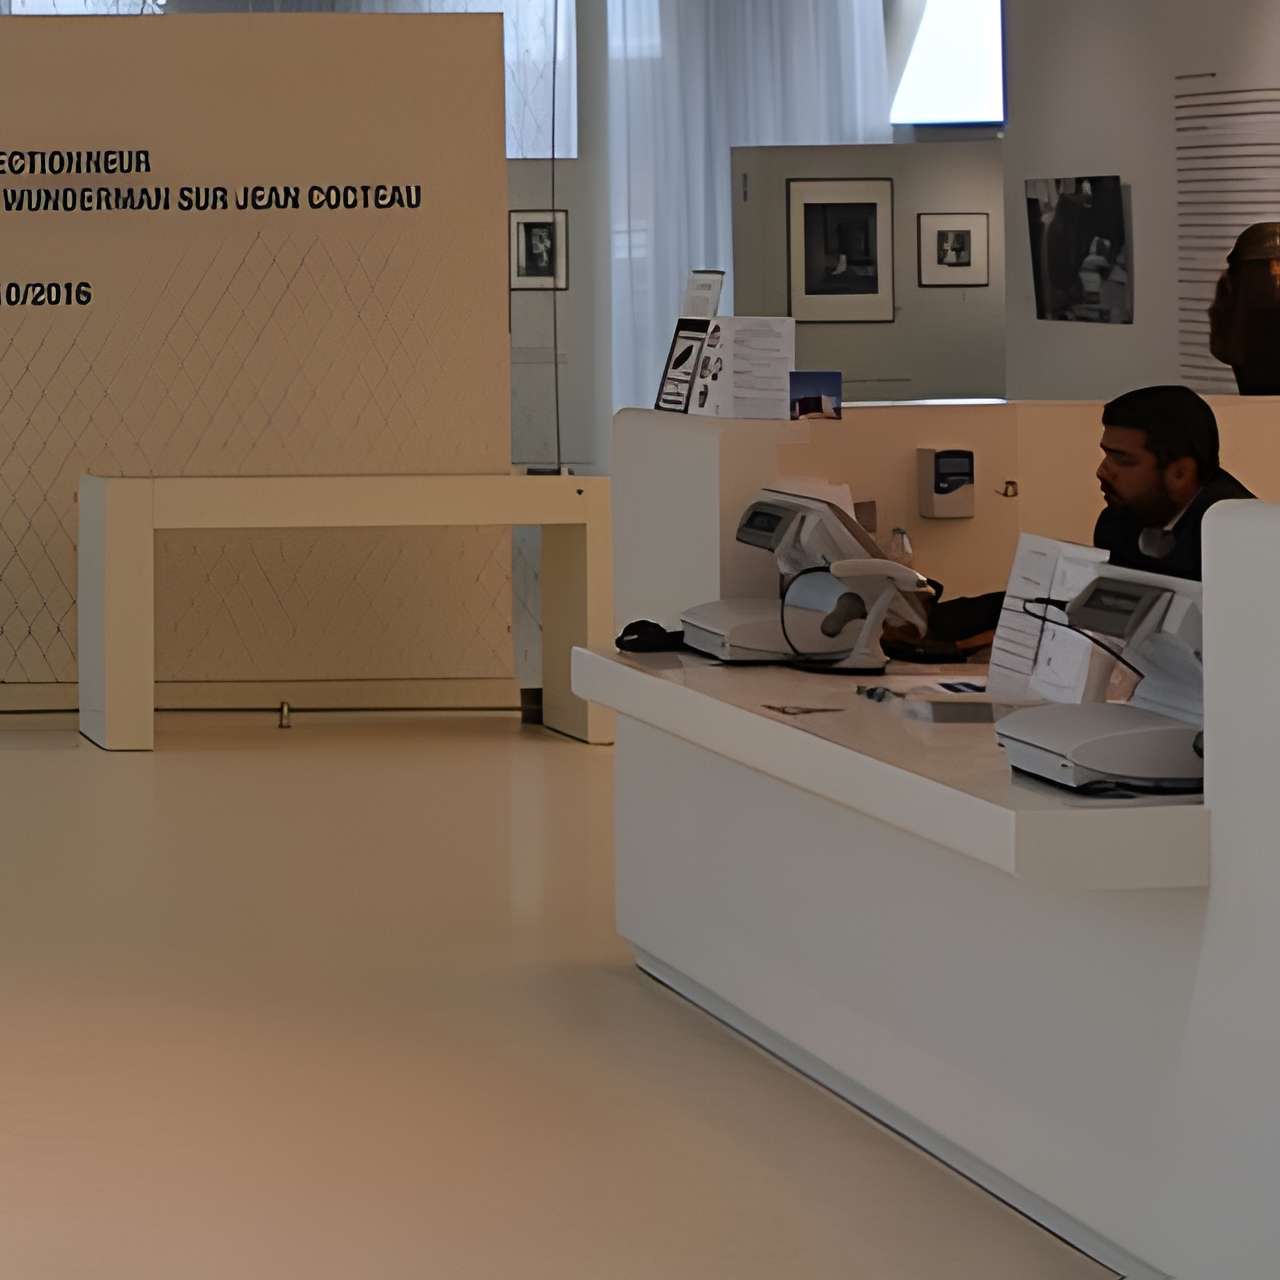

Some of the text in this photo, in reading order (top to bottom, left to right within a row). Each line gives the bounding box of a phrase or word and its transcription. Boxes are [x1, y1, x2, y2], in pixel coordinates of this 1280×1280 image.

[2, 186, 170, 212] WUNDERMAN
[177, 186, 229, 212] SUR
[234, 185, 300, 211] JEAN
